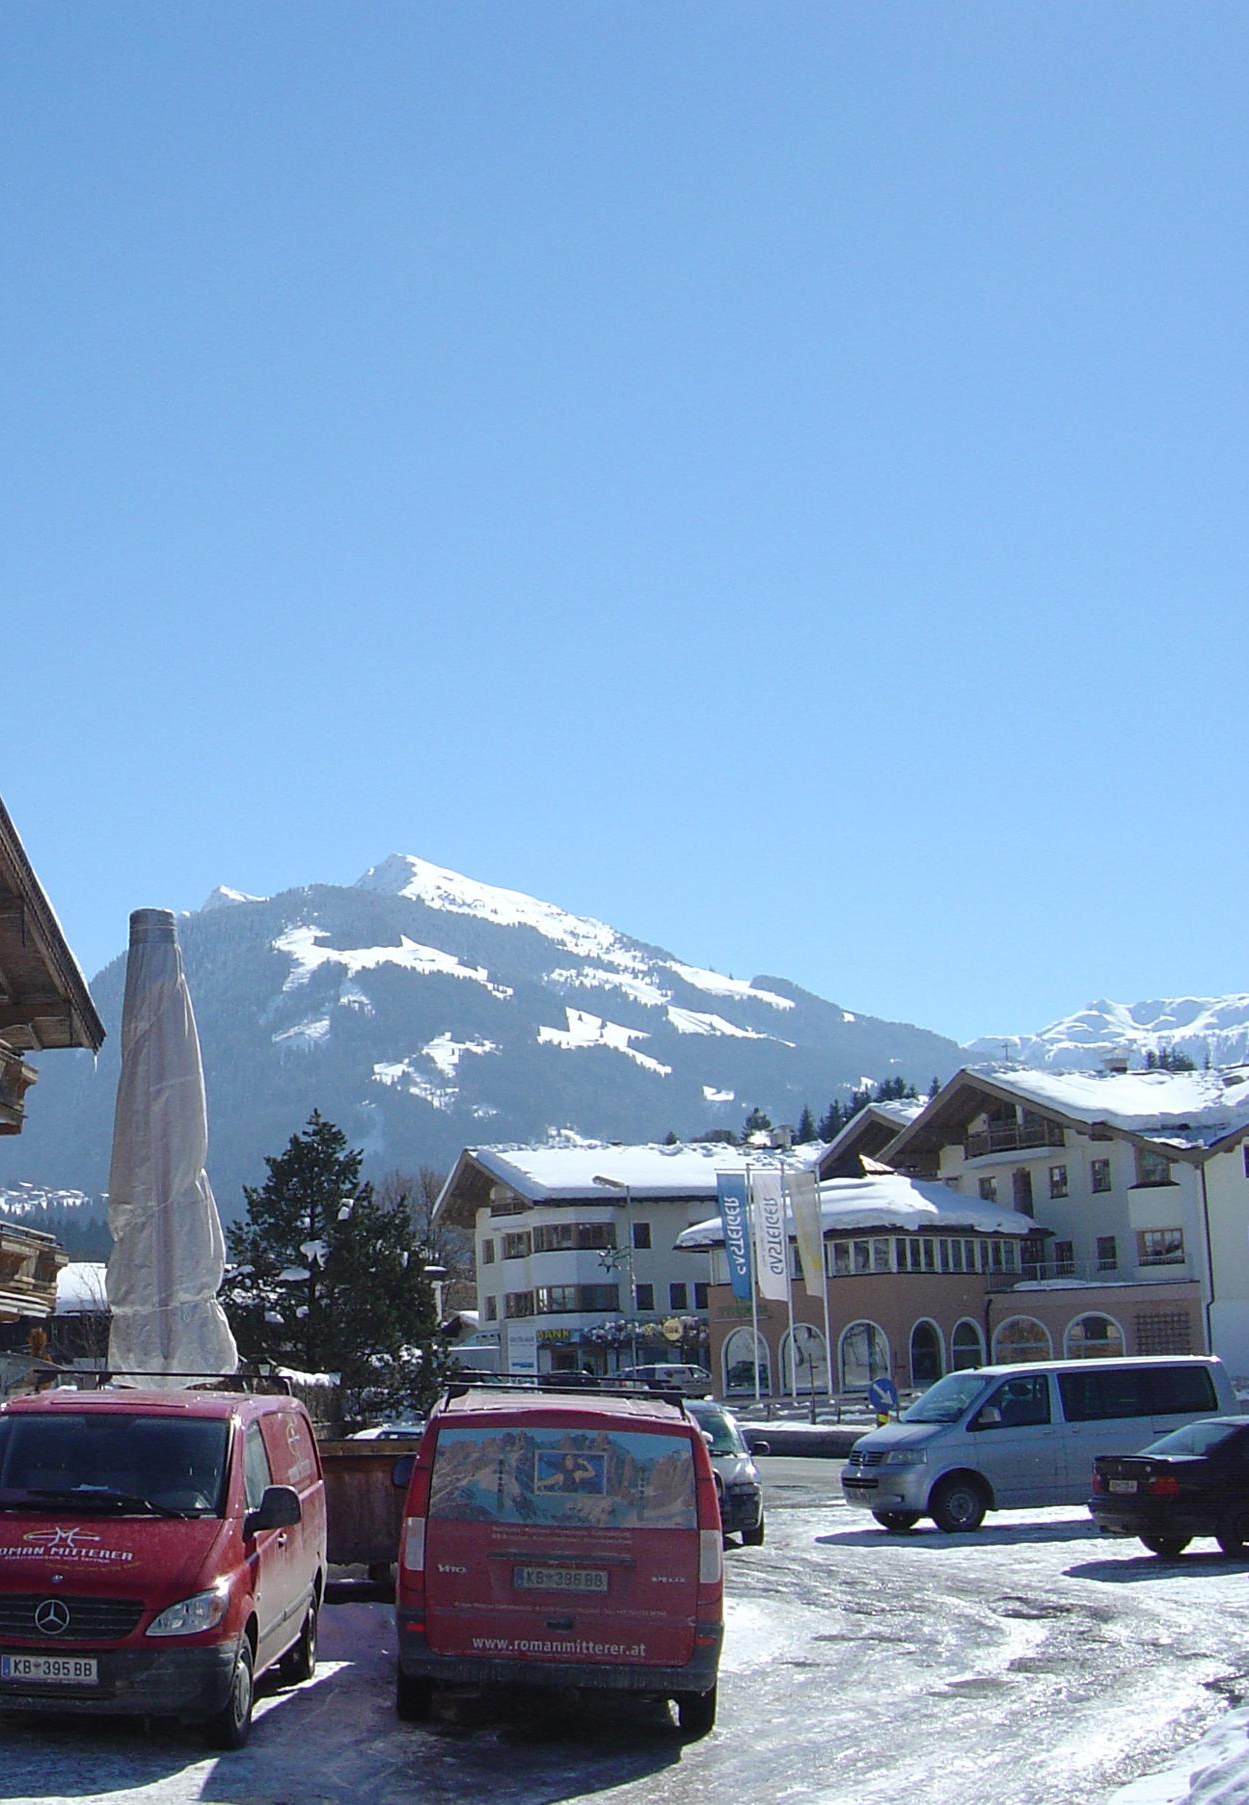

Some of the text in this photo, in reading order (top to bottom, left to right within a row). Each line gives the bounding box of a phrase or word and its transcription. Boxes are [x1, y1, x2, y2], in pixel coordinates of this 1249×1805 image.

[50, 1547, 134, 1561] MITTERER
[472, 1636, 646, 1657] www.romanmitterer.at
[13, 1659, 31, 1674] KB
